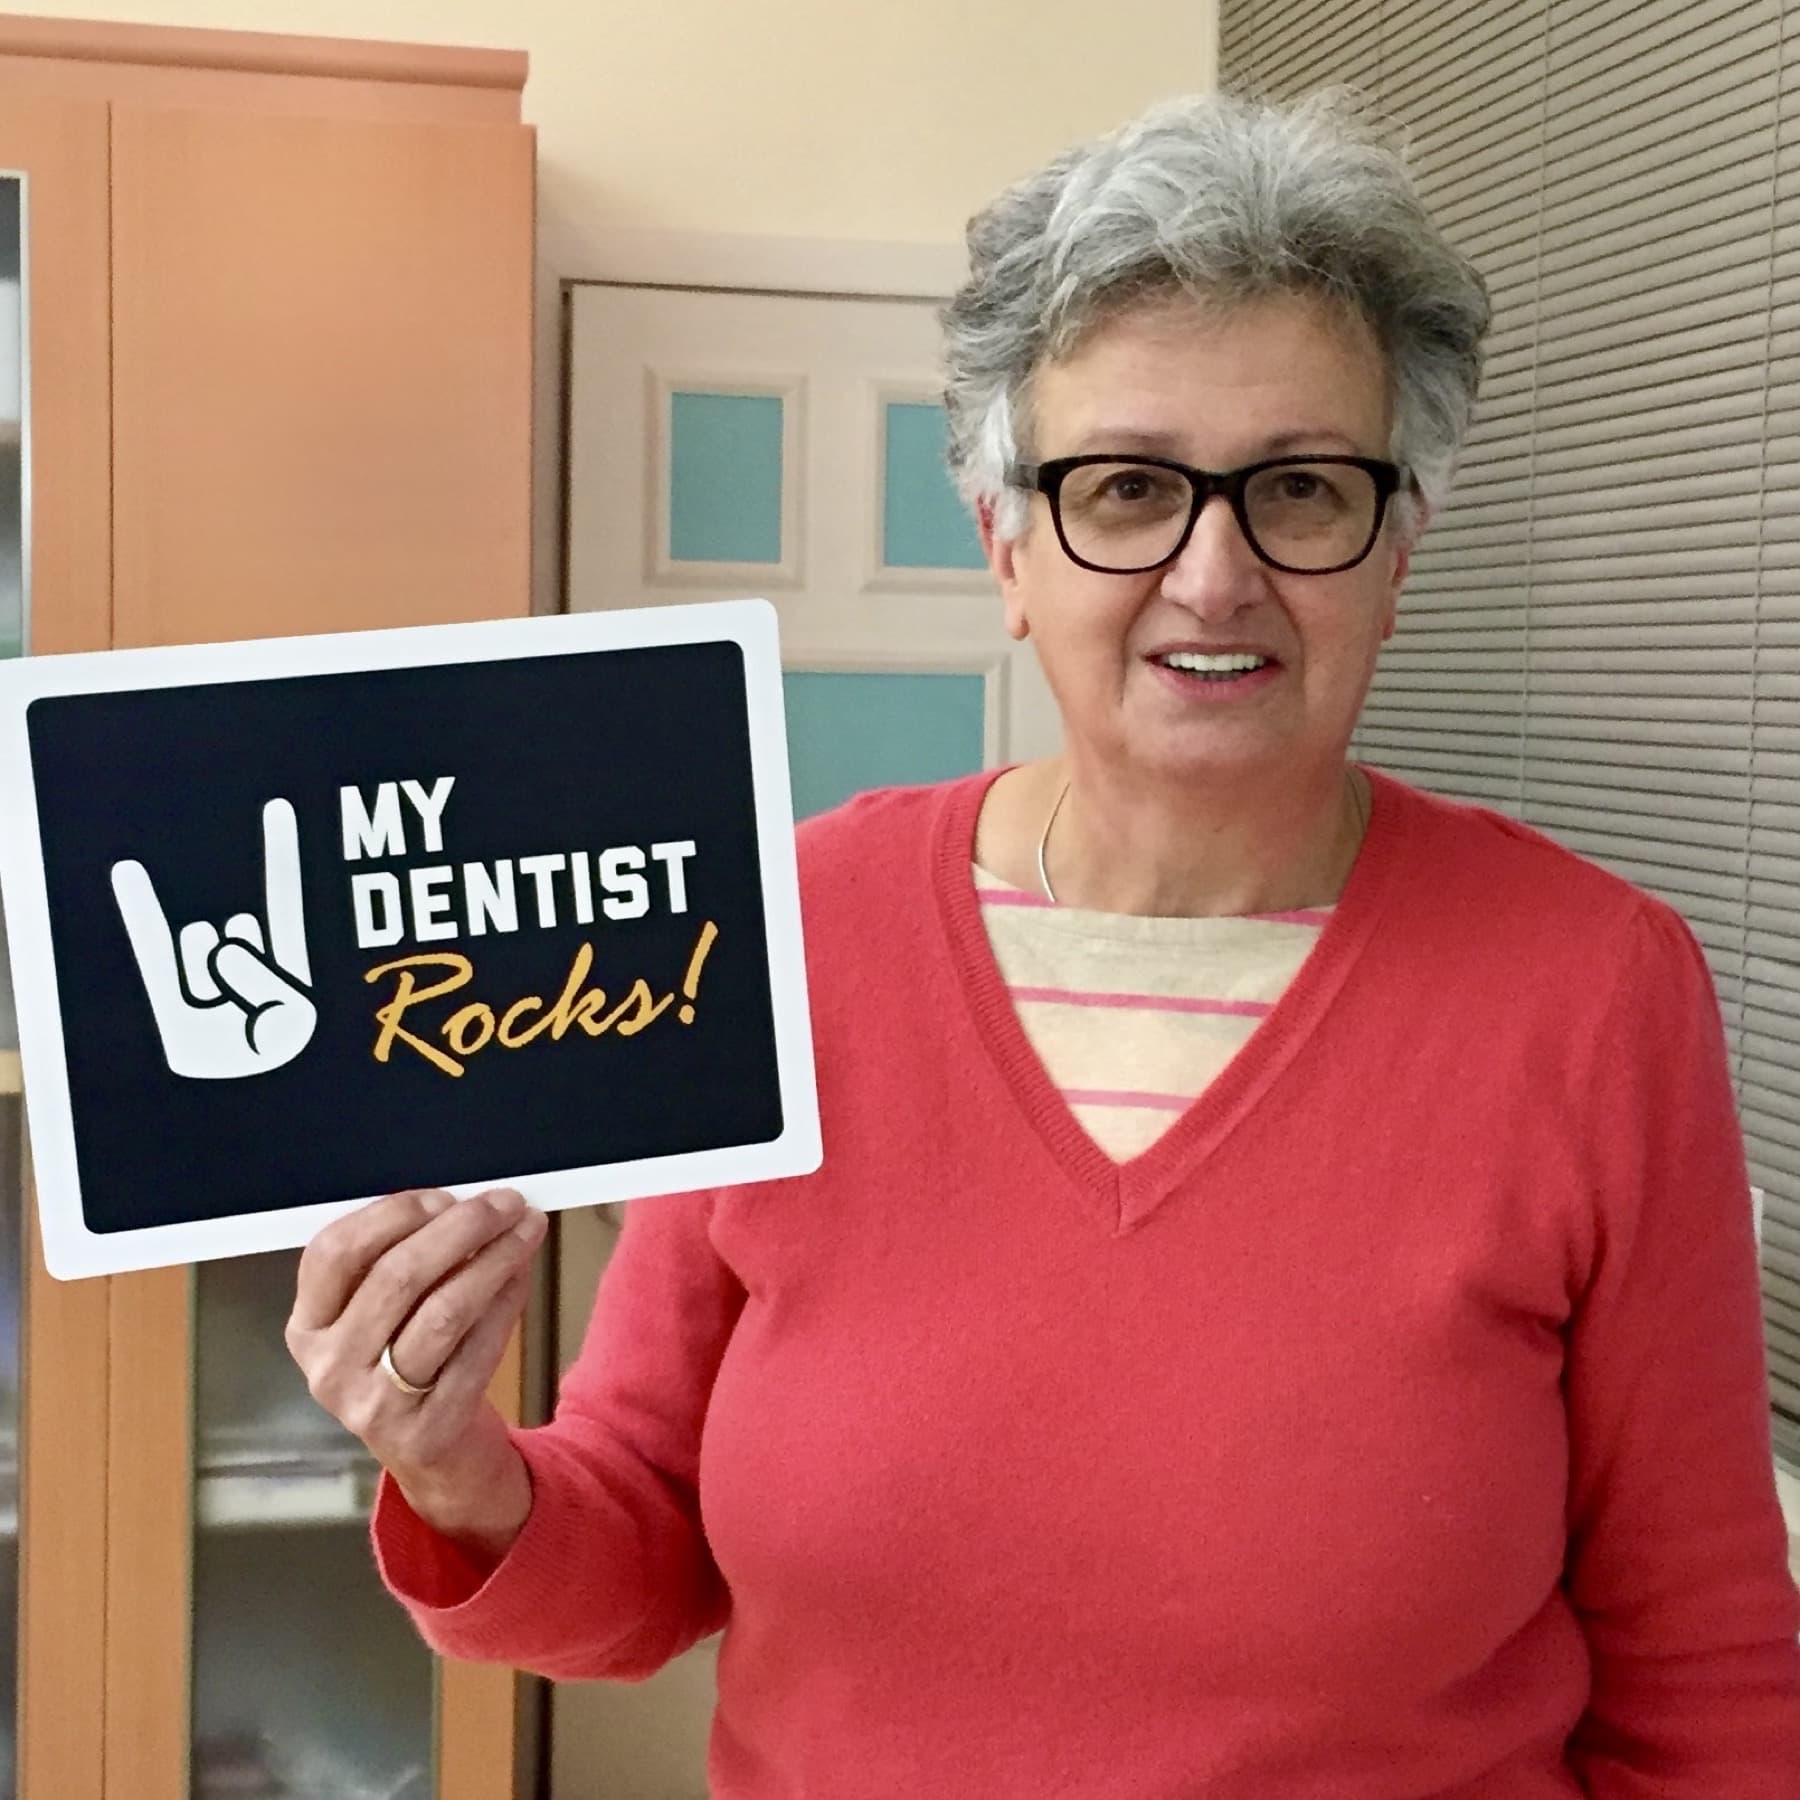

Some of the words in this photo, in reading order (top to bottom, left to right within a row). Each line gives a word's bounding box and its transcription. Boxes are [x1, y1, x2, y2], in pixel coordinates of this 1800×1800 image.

[340, 776, 456, 861] MY
[351, 840, 697, 949] DENTIST
[364, 921, 718, 1077] Rocks!
